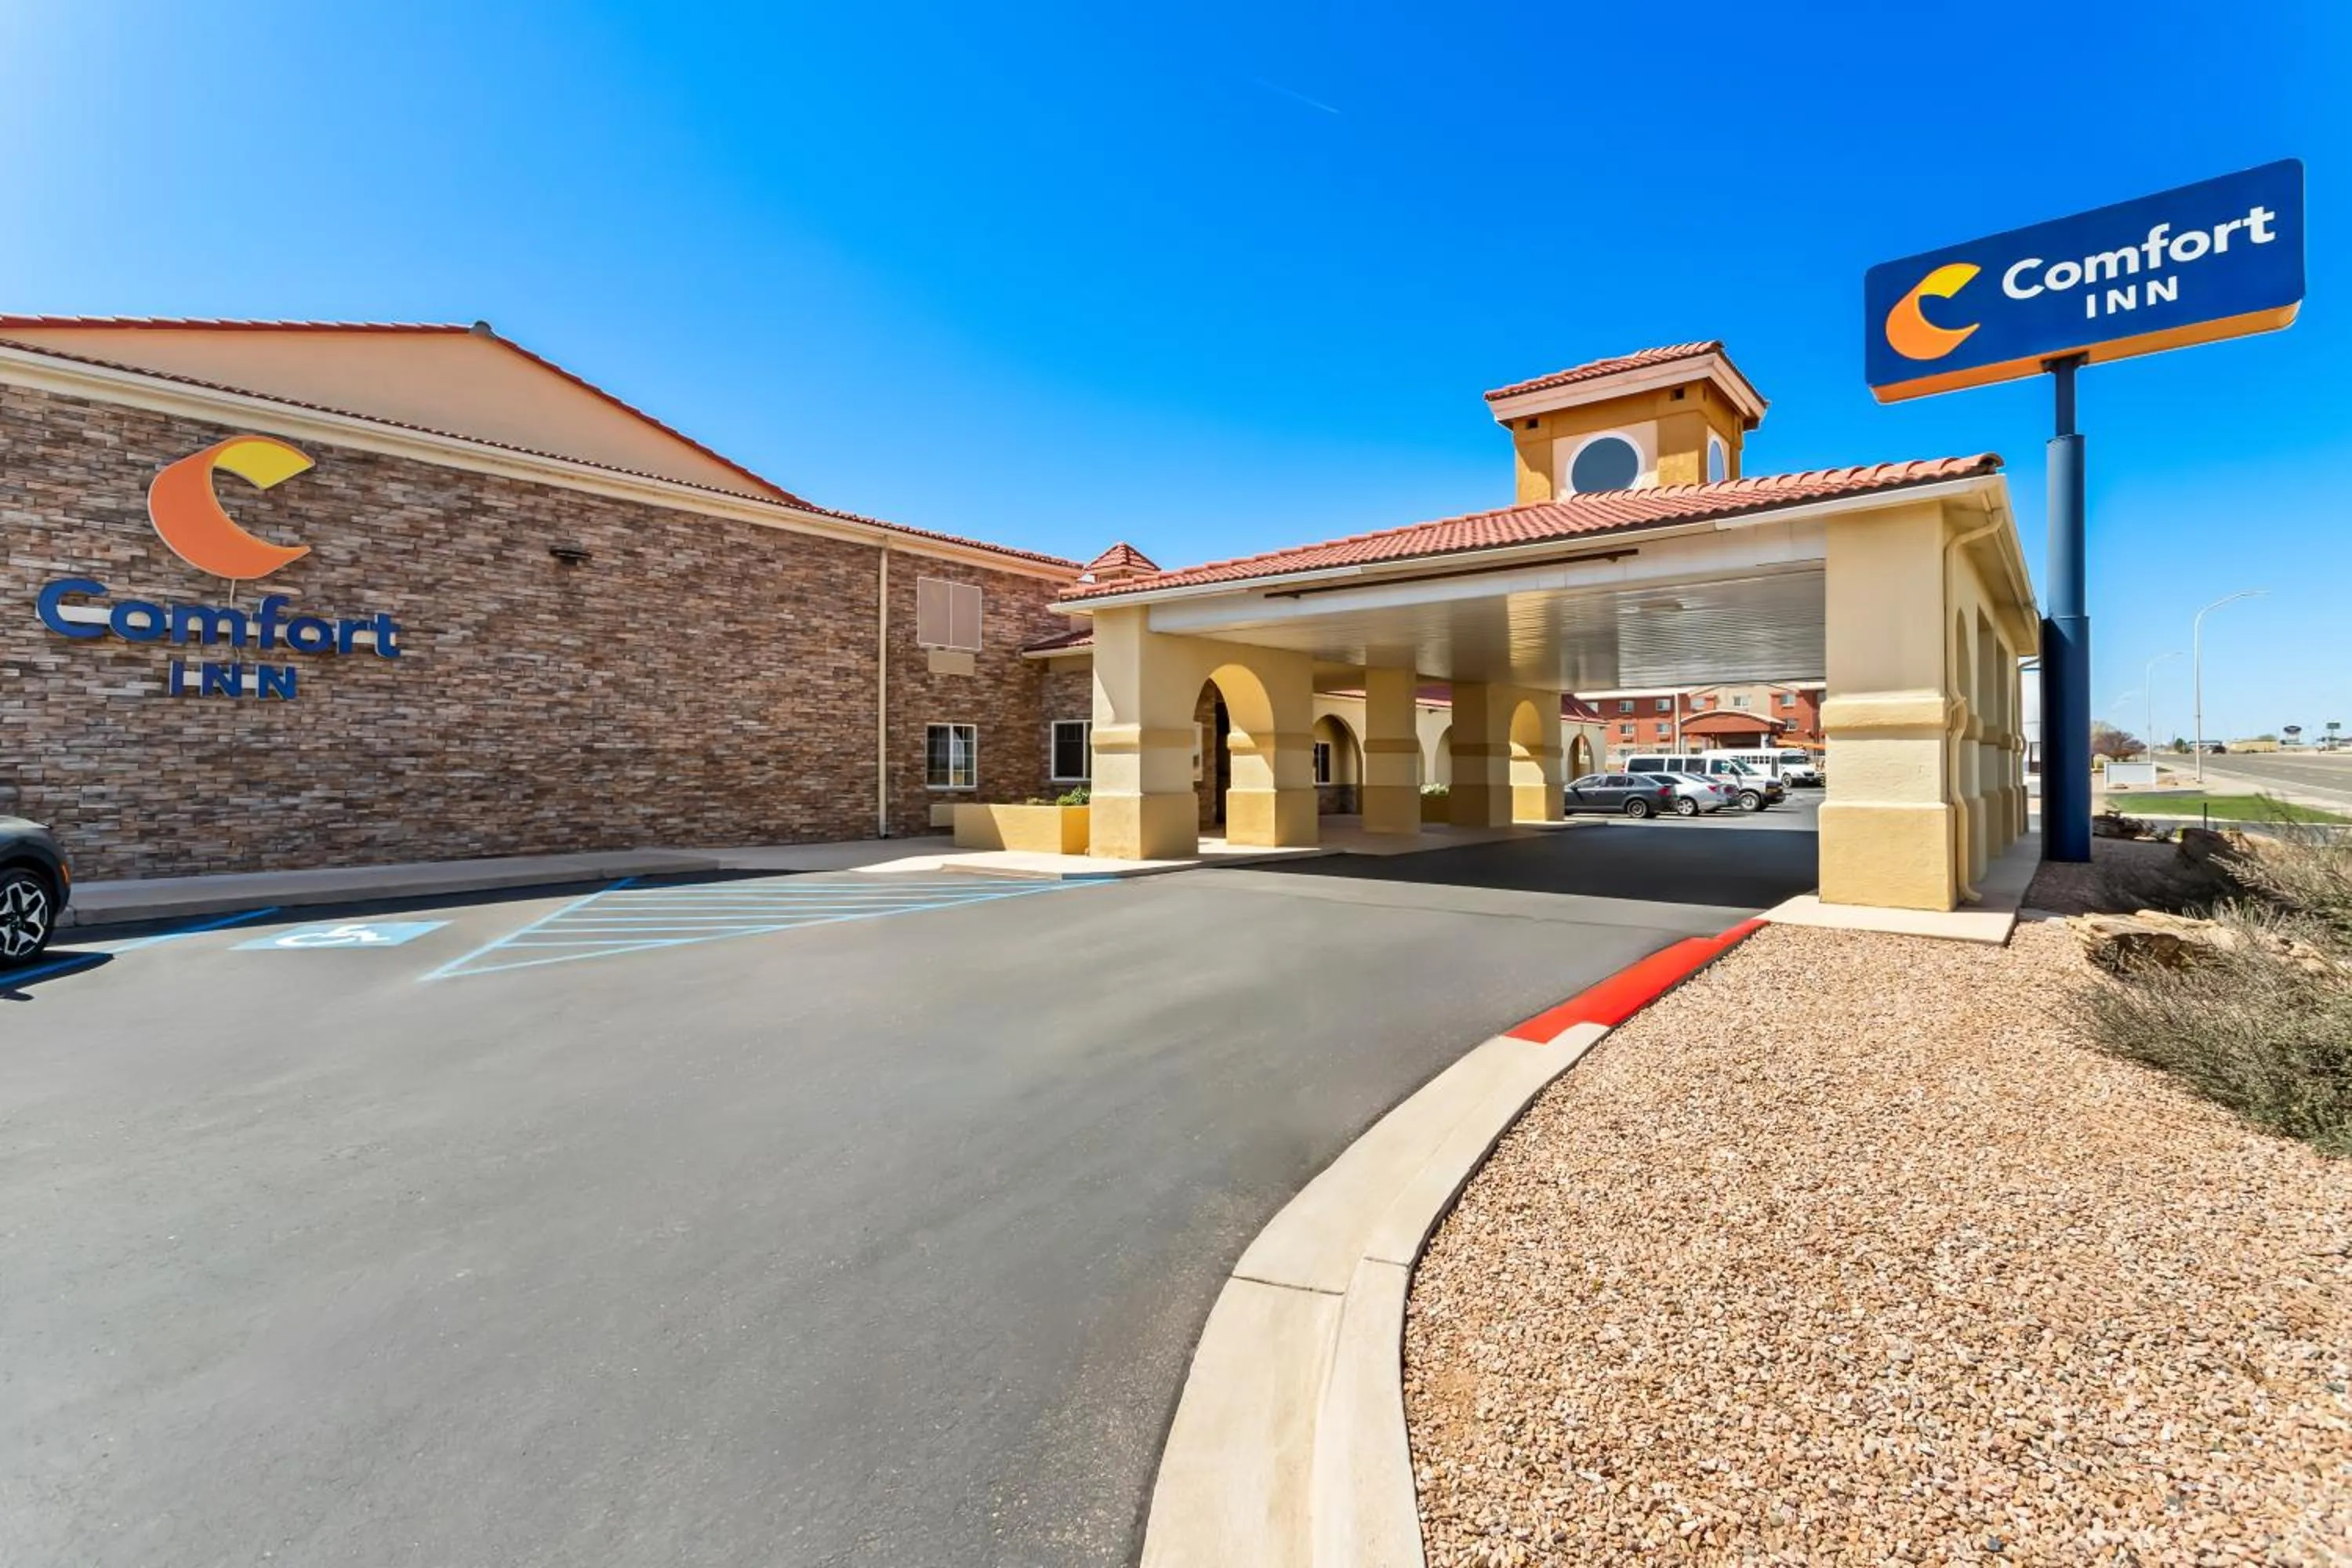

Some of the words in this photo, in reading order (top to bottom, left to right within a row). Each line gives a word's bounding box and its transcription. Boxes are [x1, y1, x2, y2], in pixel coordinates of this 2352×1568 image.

[2002, 206, 2275, 299] Comfort
[2086, 276, 2177, 319] INN
[36, 579, 401, 658] Comfort
[169, 661, 297, 699] INN
